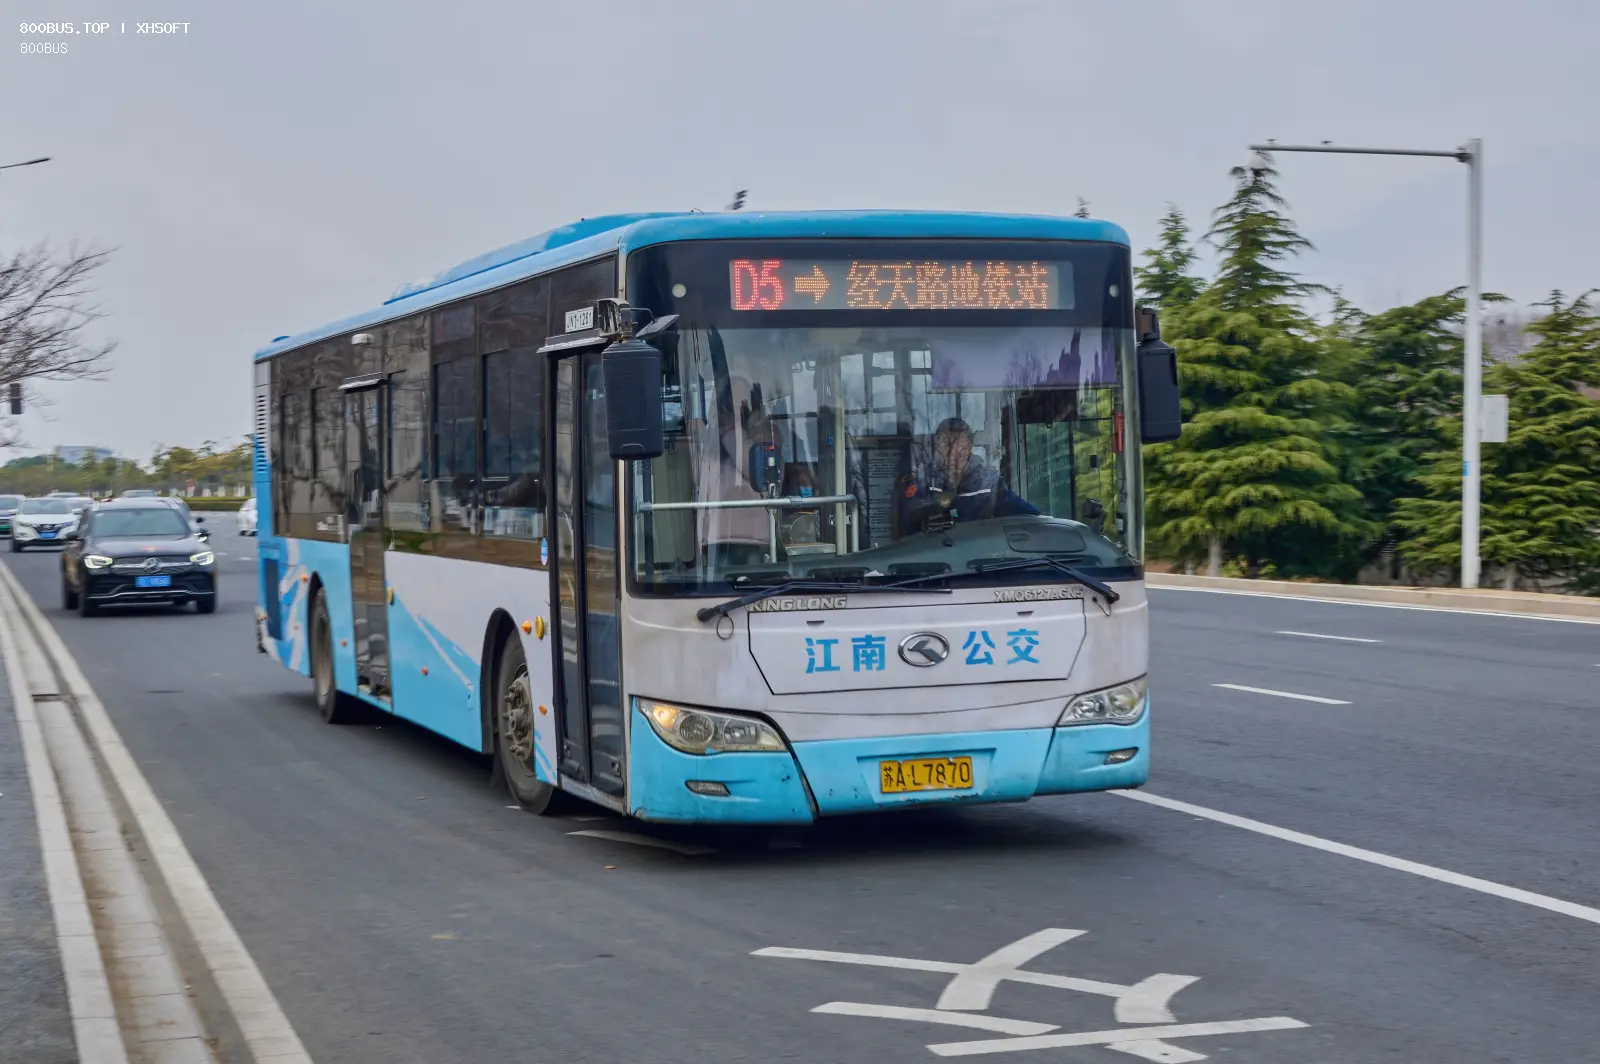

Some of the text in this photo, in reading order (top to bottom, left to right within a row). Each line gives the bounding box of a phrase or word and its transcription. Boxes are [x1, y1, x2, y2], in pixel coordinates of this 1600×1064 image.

[734, 260, 783, 311] D5
[846, 261, 1049, 310] 经天路地铁站
[748, 596, 847, 612] KING LONG
[804, 628, 1040, 674] 江南 公交
